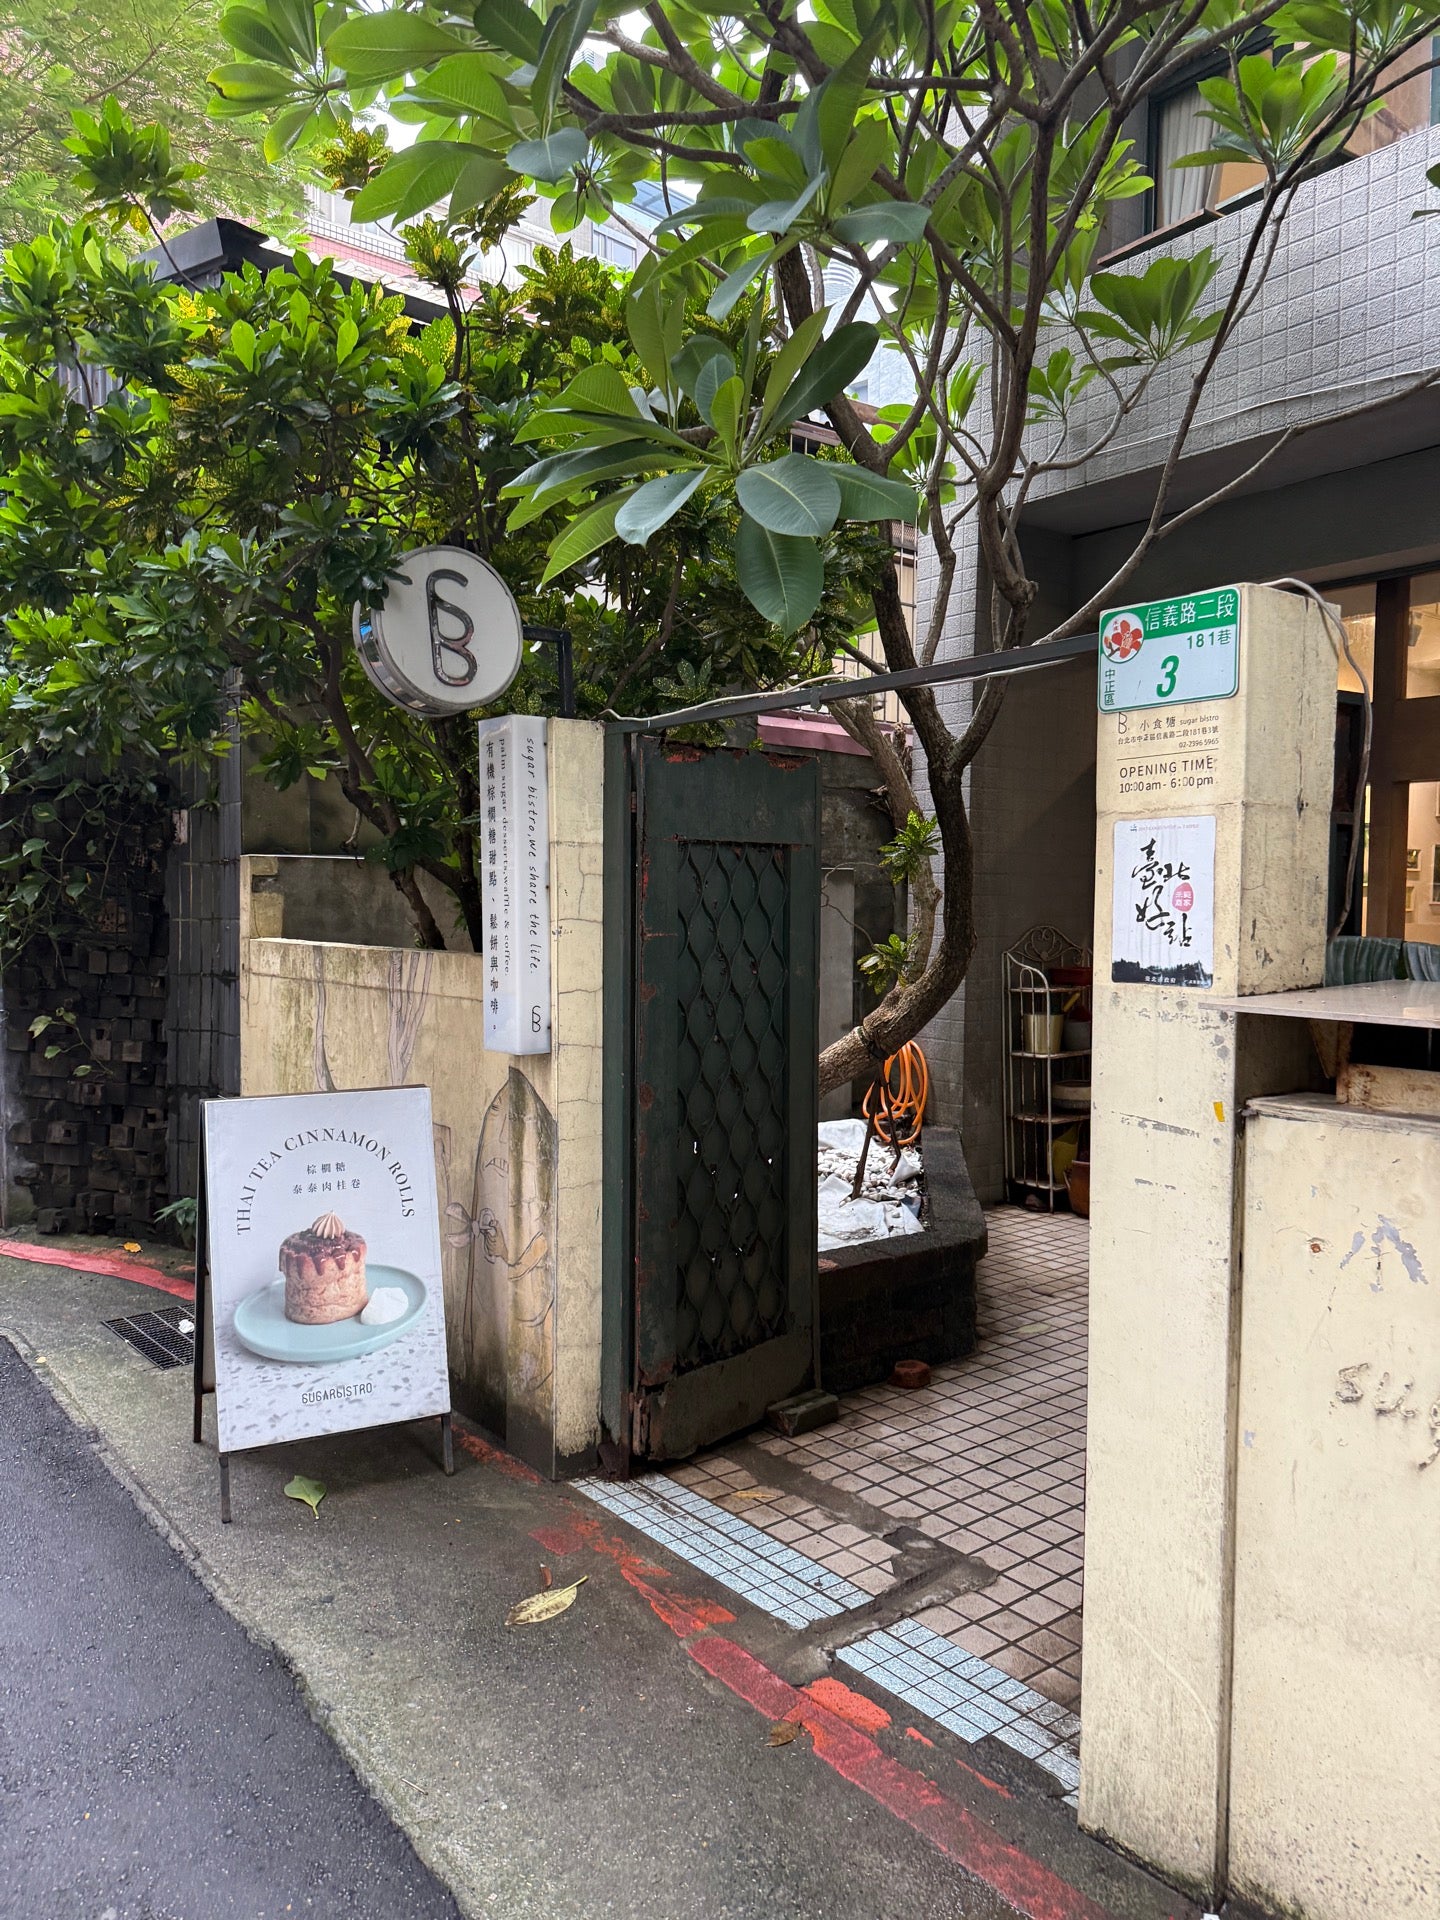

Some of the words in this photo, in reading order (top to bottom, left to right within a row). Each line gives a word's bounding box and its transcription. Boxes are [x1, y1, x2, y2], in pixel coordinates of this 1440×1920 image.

[1145, 593, 1236, 631] 信義路二段
[1187, 629, 1231, 650] 181巷
[1104, 668, 1116, 706] 中正區
[1156, 655, 1180, 698] 3
[1179, 717, 1198, 726] sugar
[1199, 714, 1219, 723] bistro
[499, 738, 507, 770] palm
[521, 737, 535, 779] sugar
[1119, 761, 1177, 779] OPENING
[1182, 757, 1213, 772] TIME
[1196, 776, 1214, 789] pm
[529, 866, 540, 904] share
[529, 914, 540, 935] the
[236, 1185, 256, 1235] THAI
[248, 1150, 283, 1181] TEA
[284, 1128, 392, 1162] CINNAMON
[388, 1161, 415, 1218] ROLLS
[292, 1178, 361, 1195] 泰泰肉桂卷
